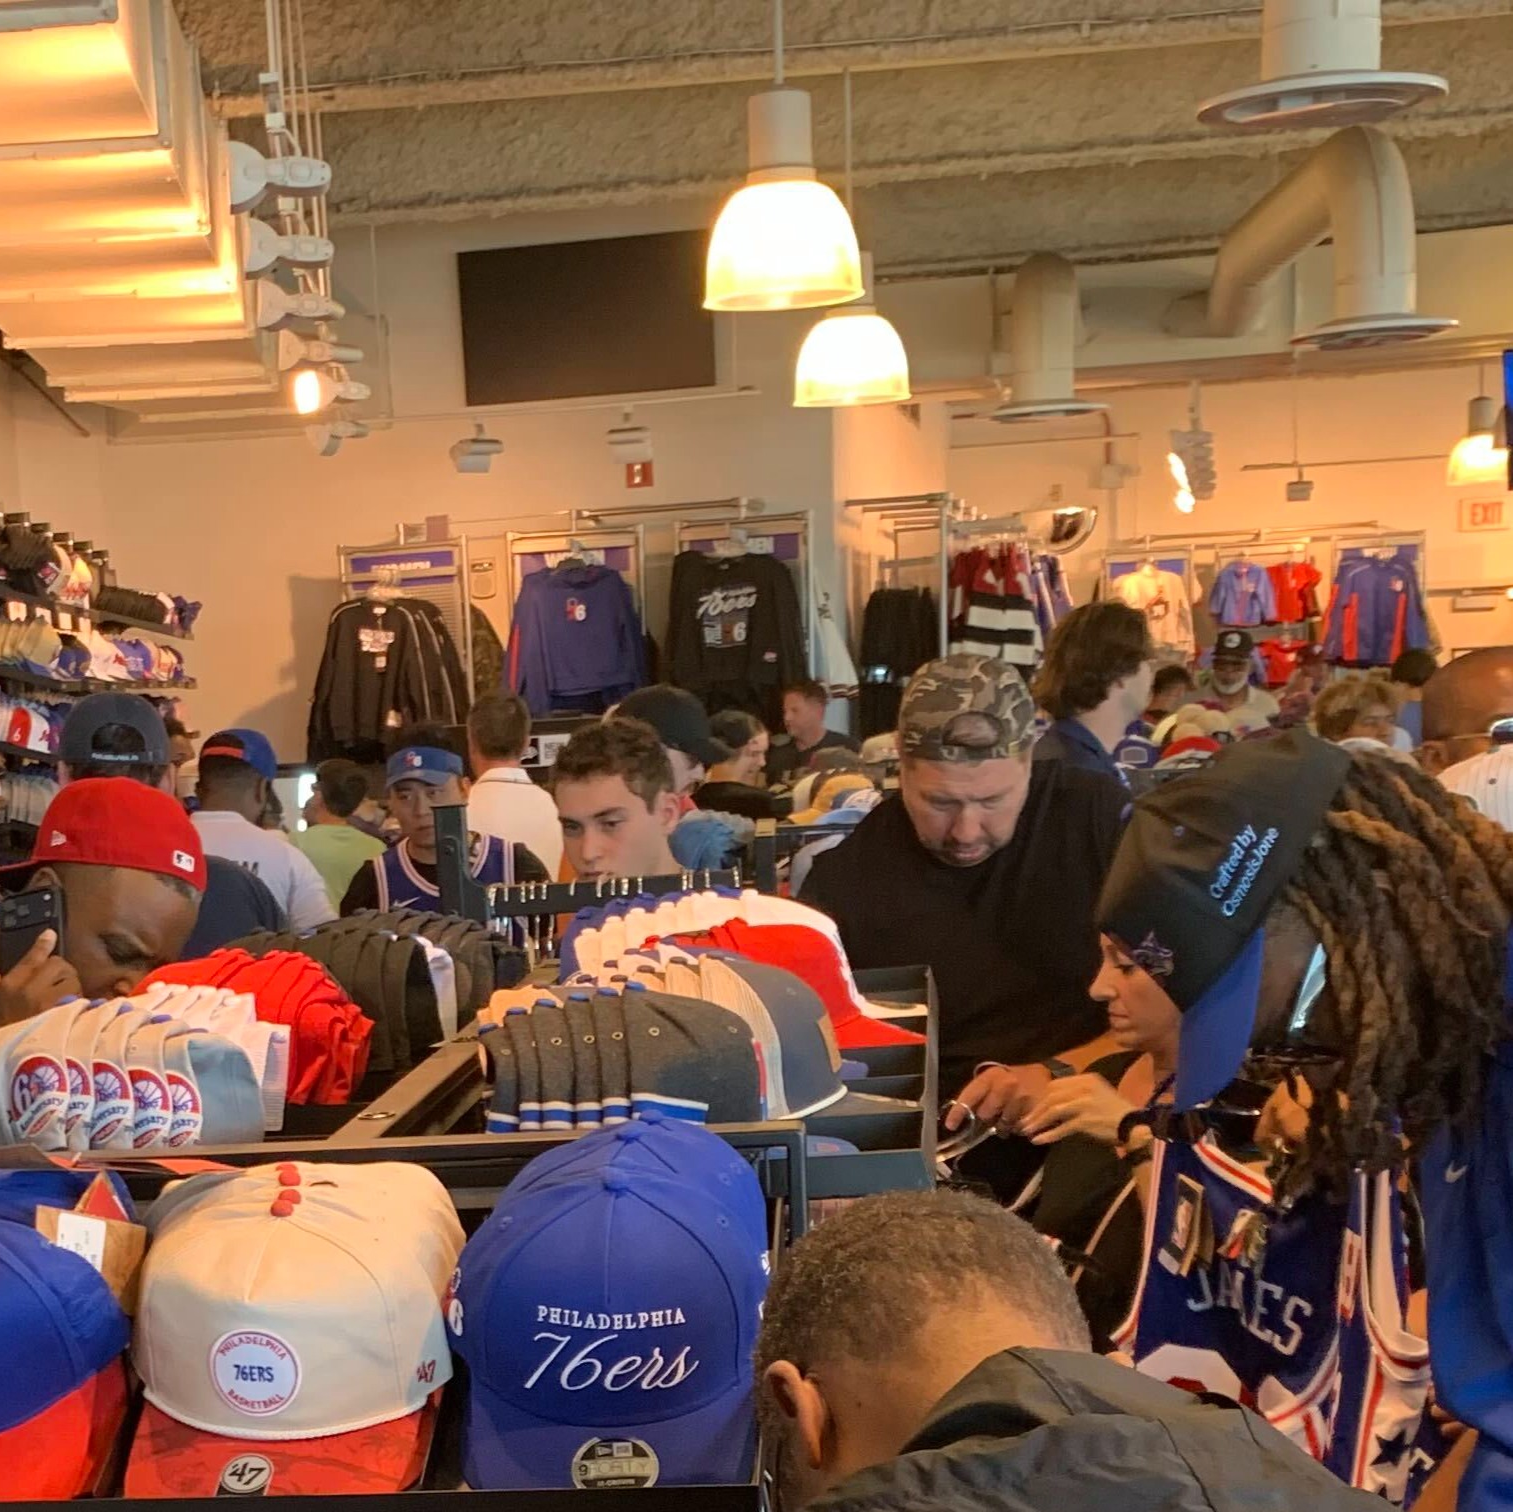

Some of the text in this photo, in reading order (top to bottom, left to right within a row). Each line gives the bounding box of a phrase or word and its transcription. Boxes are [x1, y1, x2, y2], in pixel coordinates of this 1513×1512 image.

[1470, 502, 1503, 526] EXIT
[1210, 824, 1257, 899] Crafted by
[536, 1304, 687, 1331] PHILADELPHIA
[217, 1335, 287, 1361] PHILADELPHIA
[233, 1364, 275, 1383] 76ERS
[523, 1331, 701, 1393] 76ers
[227, 1387, 285, 1410] BASKETBALL
